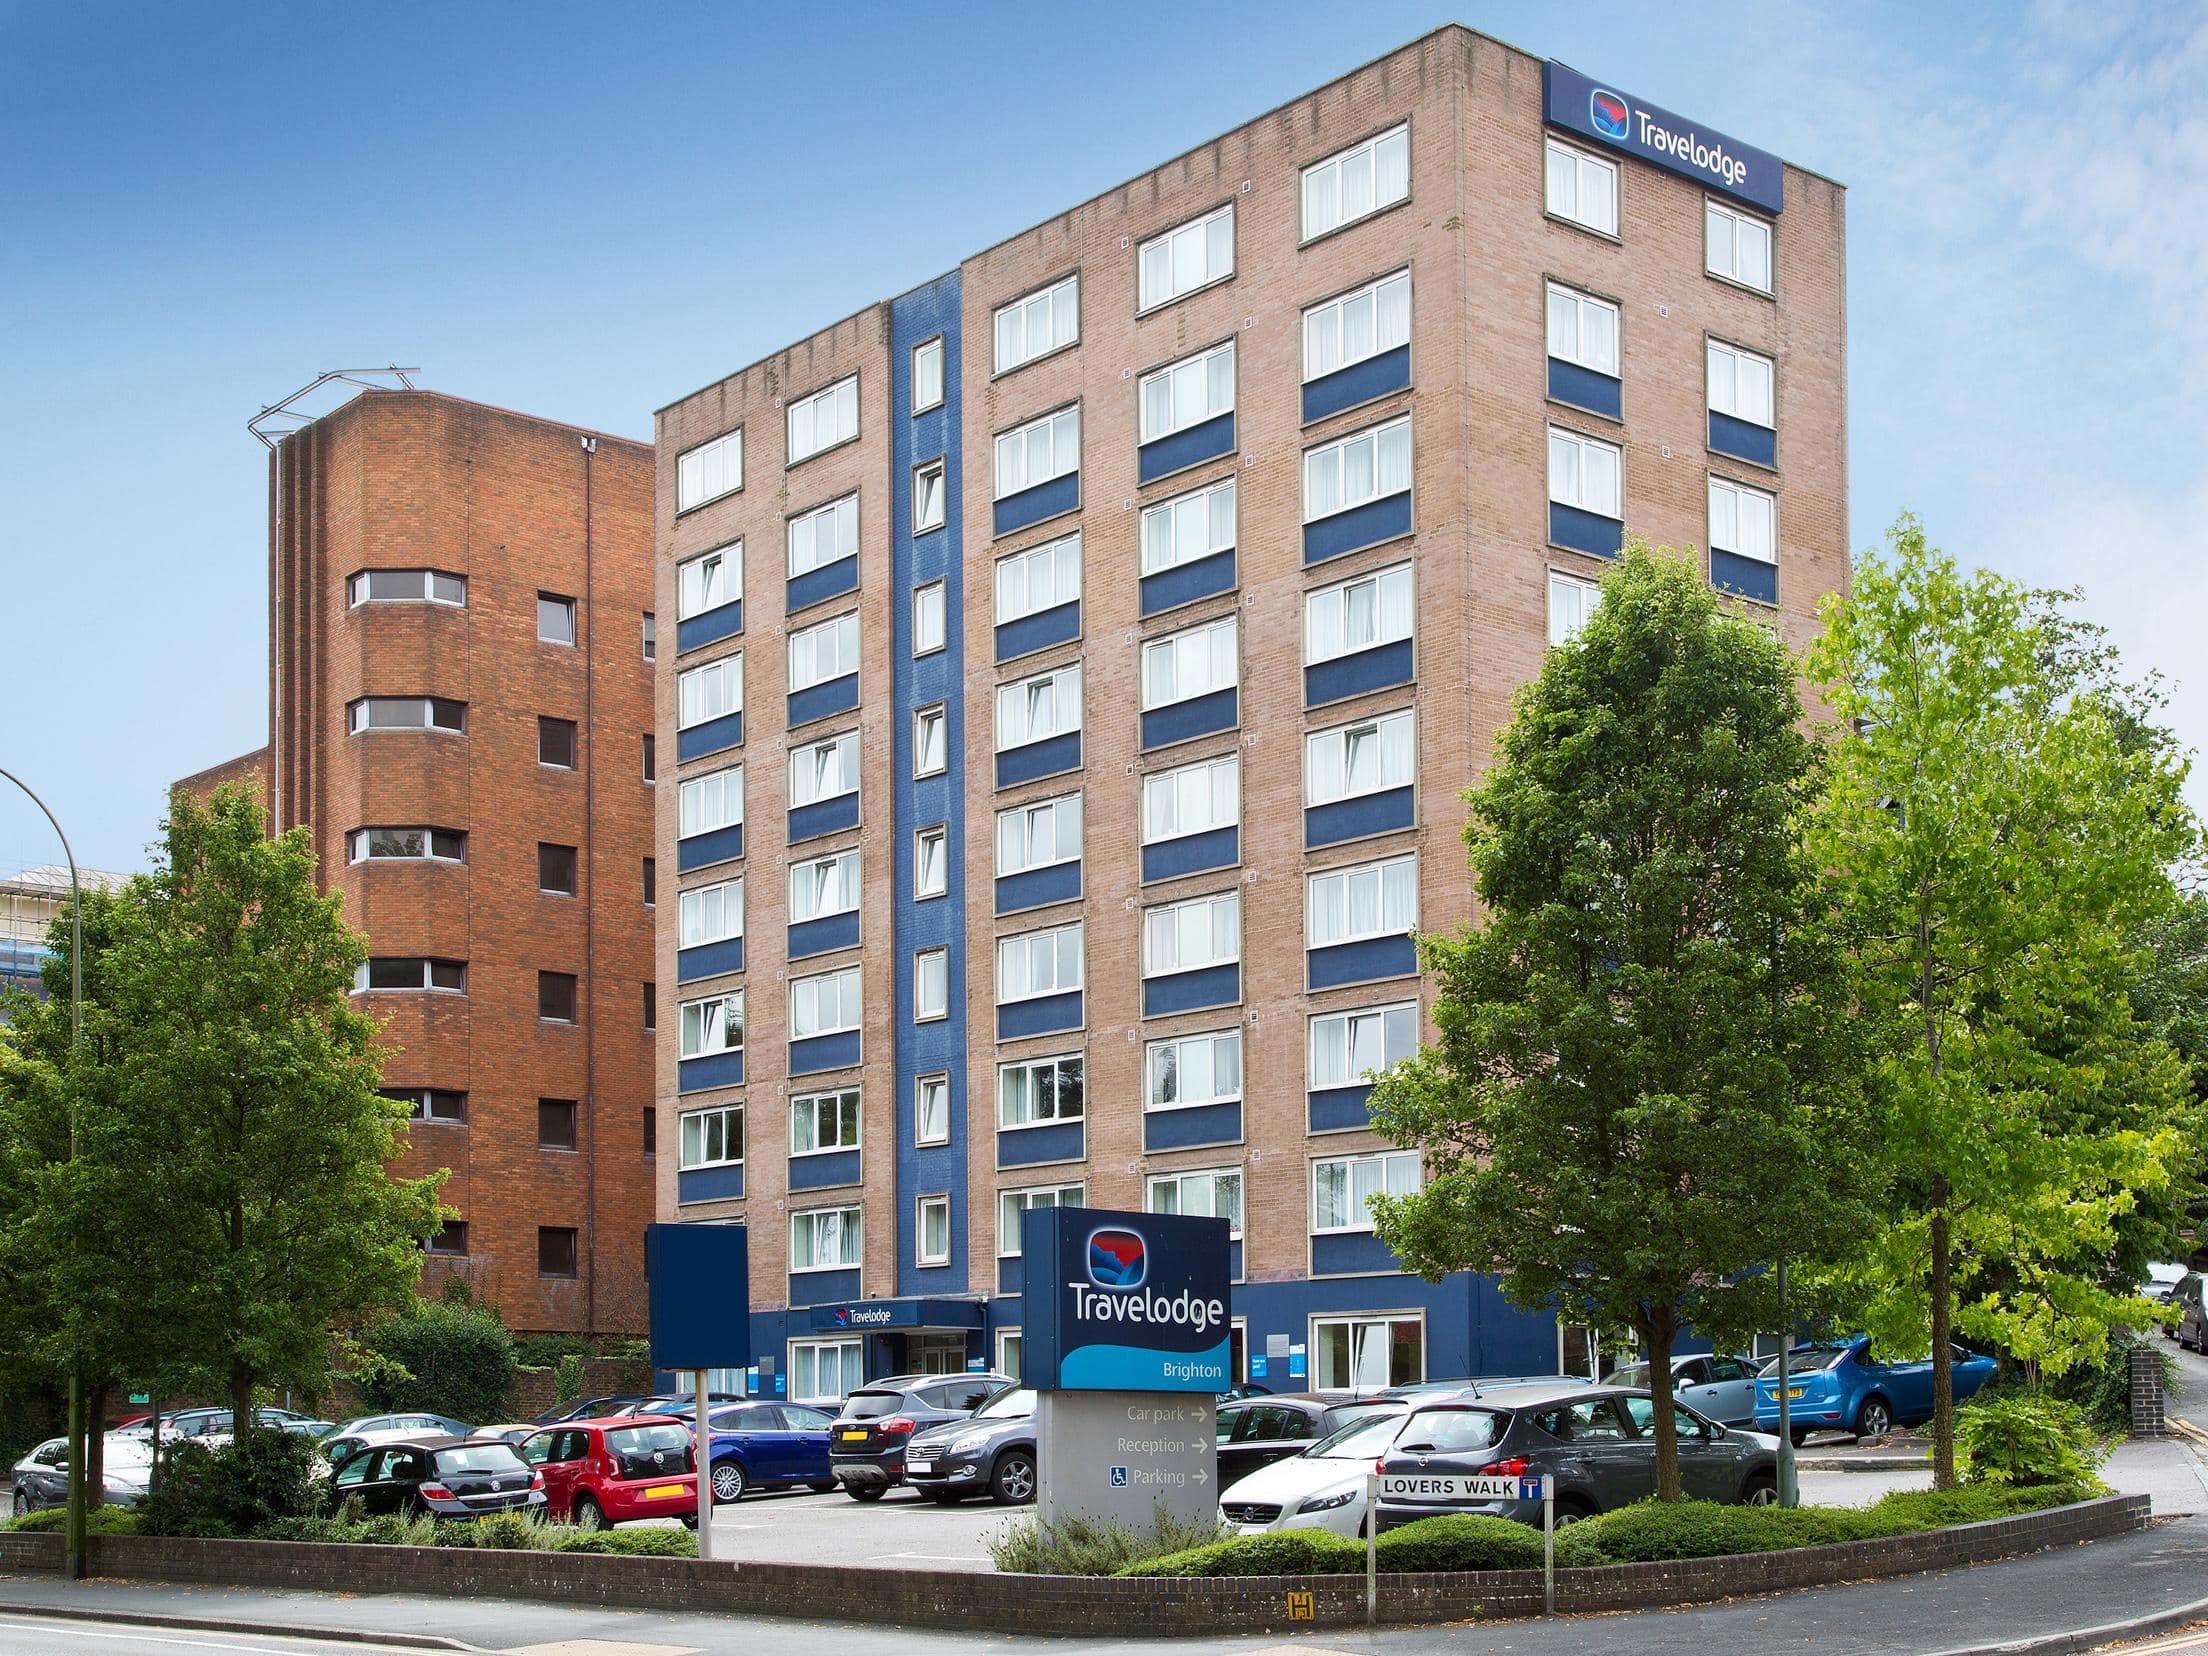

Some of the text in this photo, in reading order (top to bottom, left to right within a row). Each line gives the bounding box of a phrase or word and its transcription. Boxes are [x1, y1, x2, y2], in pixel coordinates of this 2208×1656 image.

[1635, 110, 1747, 185] Travelodge
[850, 1309, 891, 1325] Travelodge
[1068, 1282, 1224, 1333] Travelodge
[1163, 1361, 1222, 1381] Brighton
[1127, 1406, 1184, 1425] Car park
[1117, 1437, 1185, 1456] Reception
[1134, 1468, 1185, 1488] Parking
[1384, 1479, 1514, 1495] LOVERS WALK
